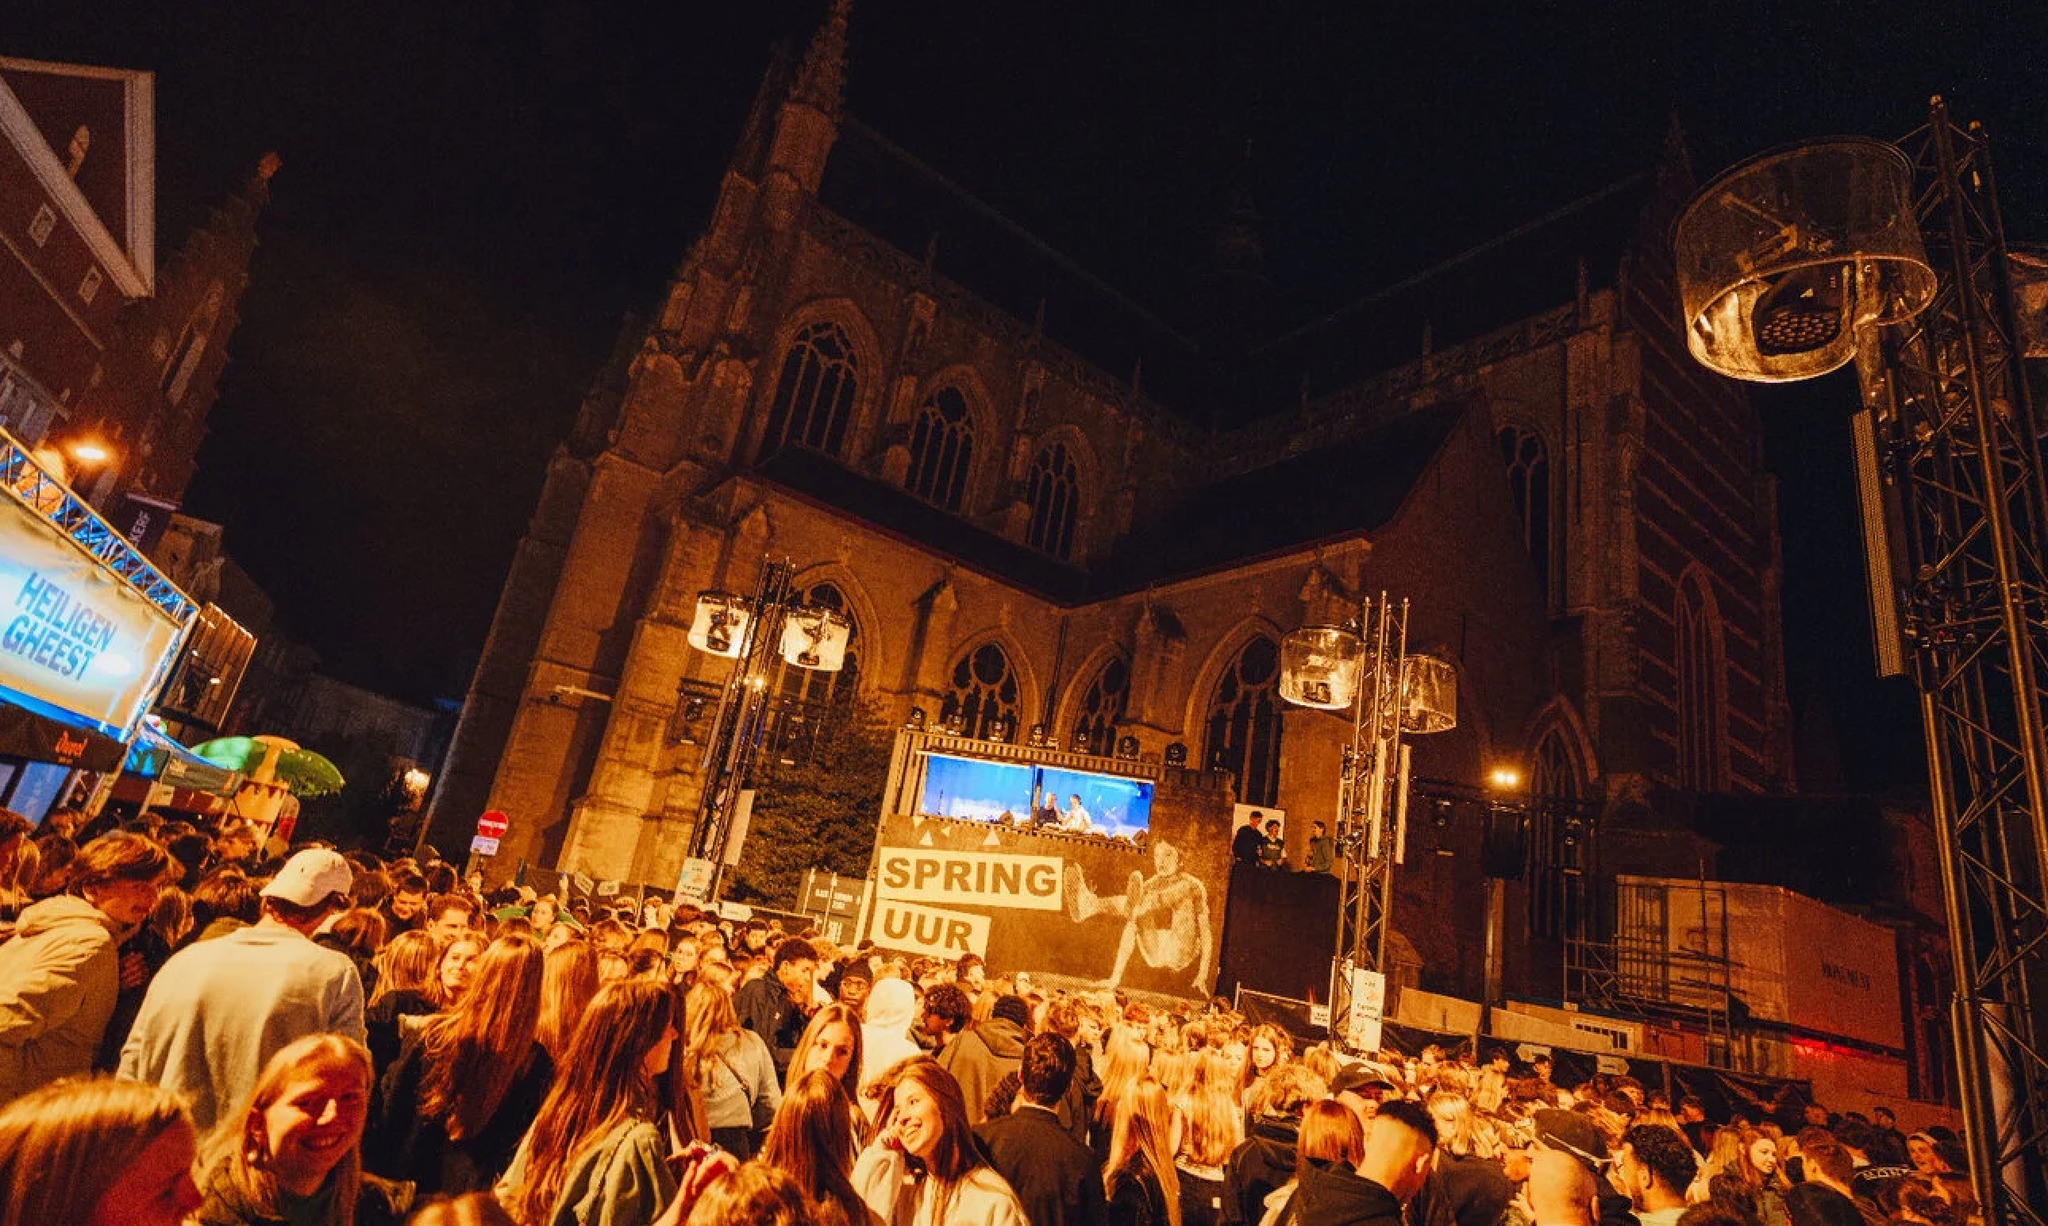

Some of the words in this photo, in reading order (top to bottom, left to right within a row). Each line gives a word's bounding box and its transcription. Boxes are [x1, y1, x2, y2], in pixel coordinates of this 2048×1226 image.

[15, 571, 117, 653] HEILIGEN
[3, 615, 95, 681] GHEEST
[884, 857, 1057, 897] SPRING
[884, 908, 973, 953] UUR
